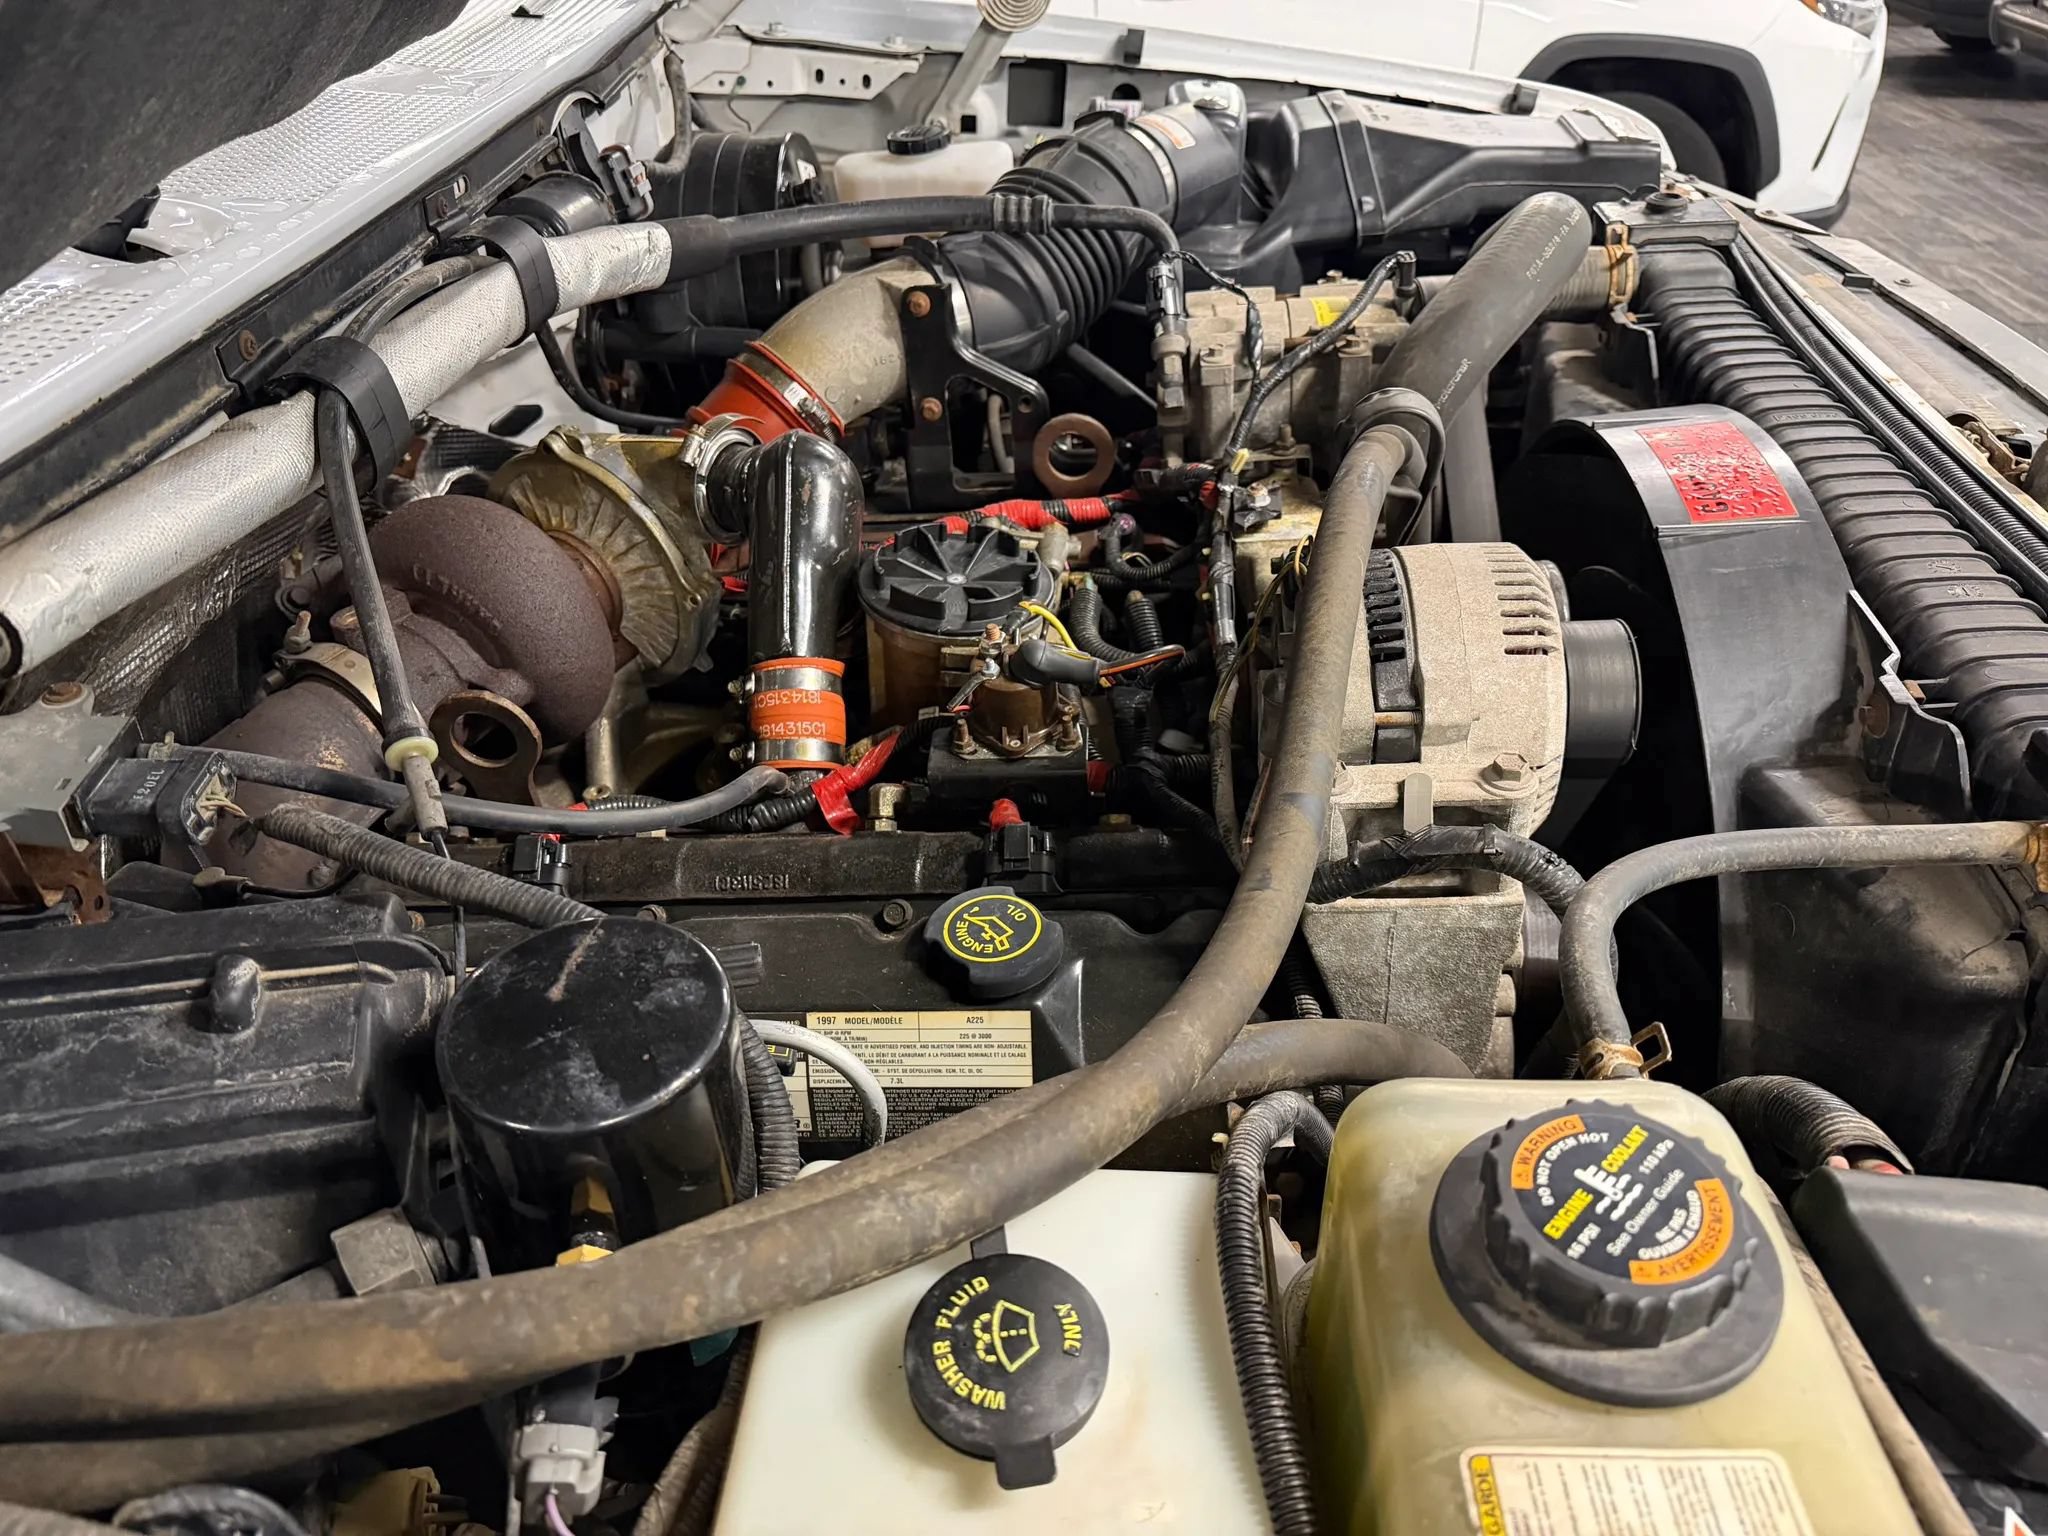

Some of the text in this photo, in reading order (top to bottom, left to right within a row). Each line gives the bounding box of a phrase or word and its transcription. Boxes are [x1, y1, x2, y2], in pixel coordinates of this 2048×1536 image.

[760, 721, 826, 737] 1814315C1
[955, 920, 993, 953] ENGINE
[1007, 904, 1027, 921] OIL
[816, 1015, 903, 1025] 1997 MODEL/MODÈLE
[966, 1016, 984, 1024] A225
[1521, 1119, 1577, 1168] WARNING
[1536, 1132, 1609, 1207] DO NOT OPEN HOT
[1543, 1124, 1649, 1240] ENGINE COOLANT
[1606, 1168, 1685, 1257] See Owner Guide
[1658, 1186, 1724, 1278] AVERTISSEMENT
[932, 1275, 1007, 1410] WASHER FLUID
[1053, 1303, 1083, 1357] ONLY
